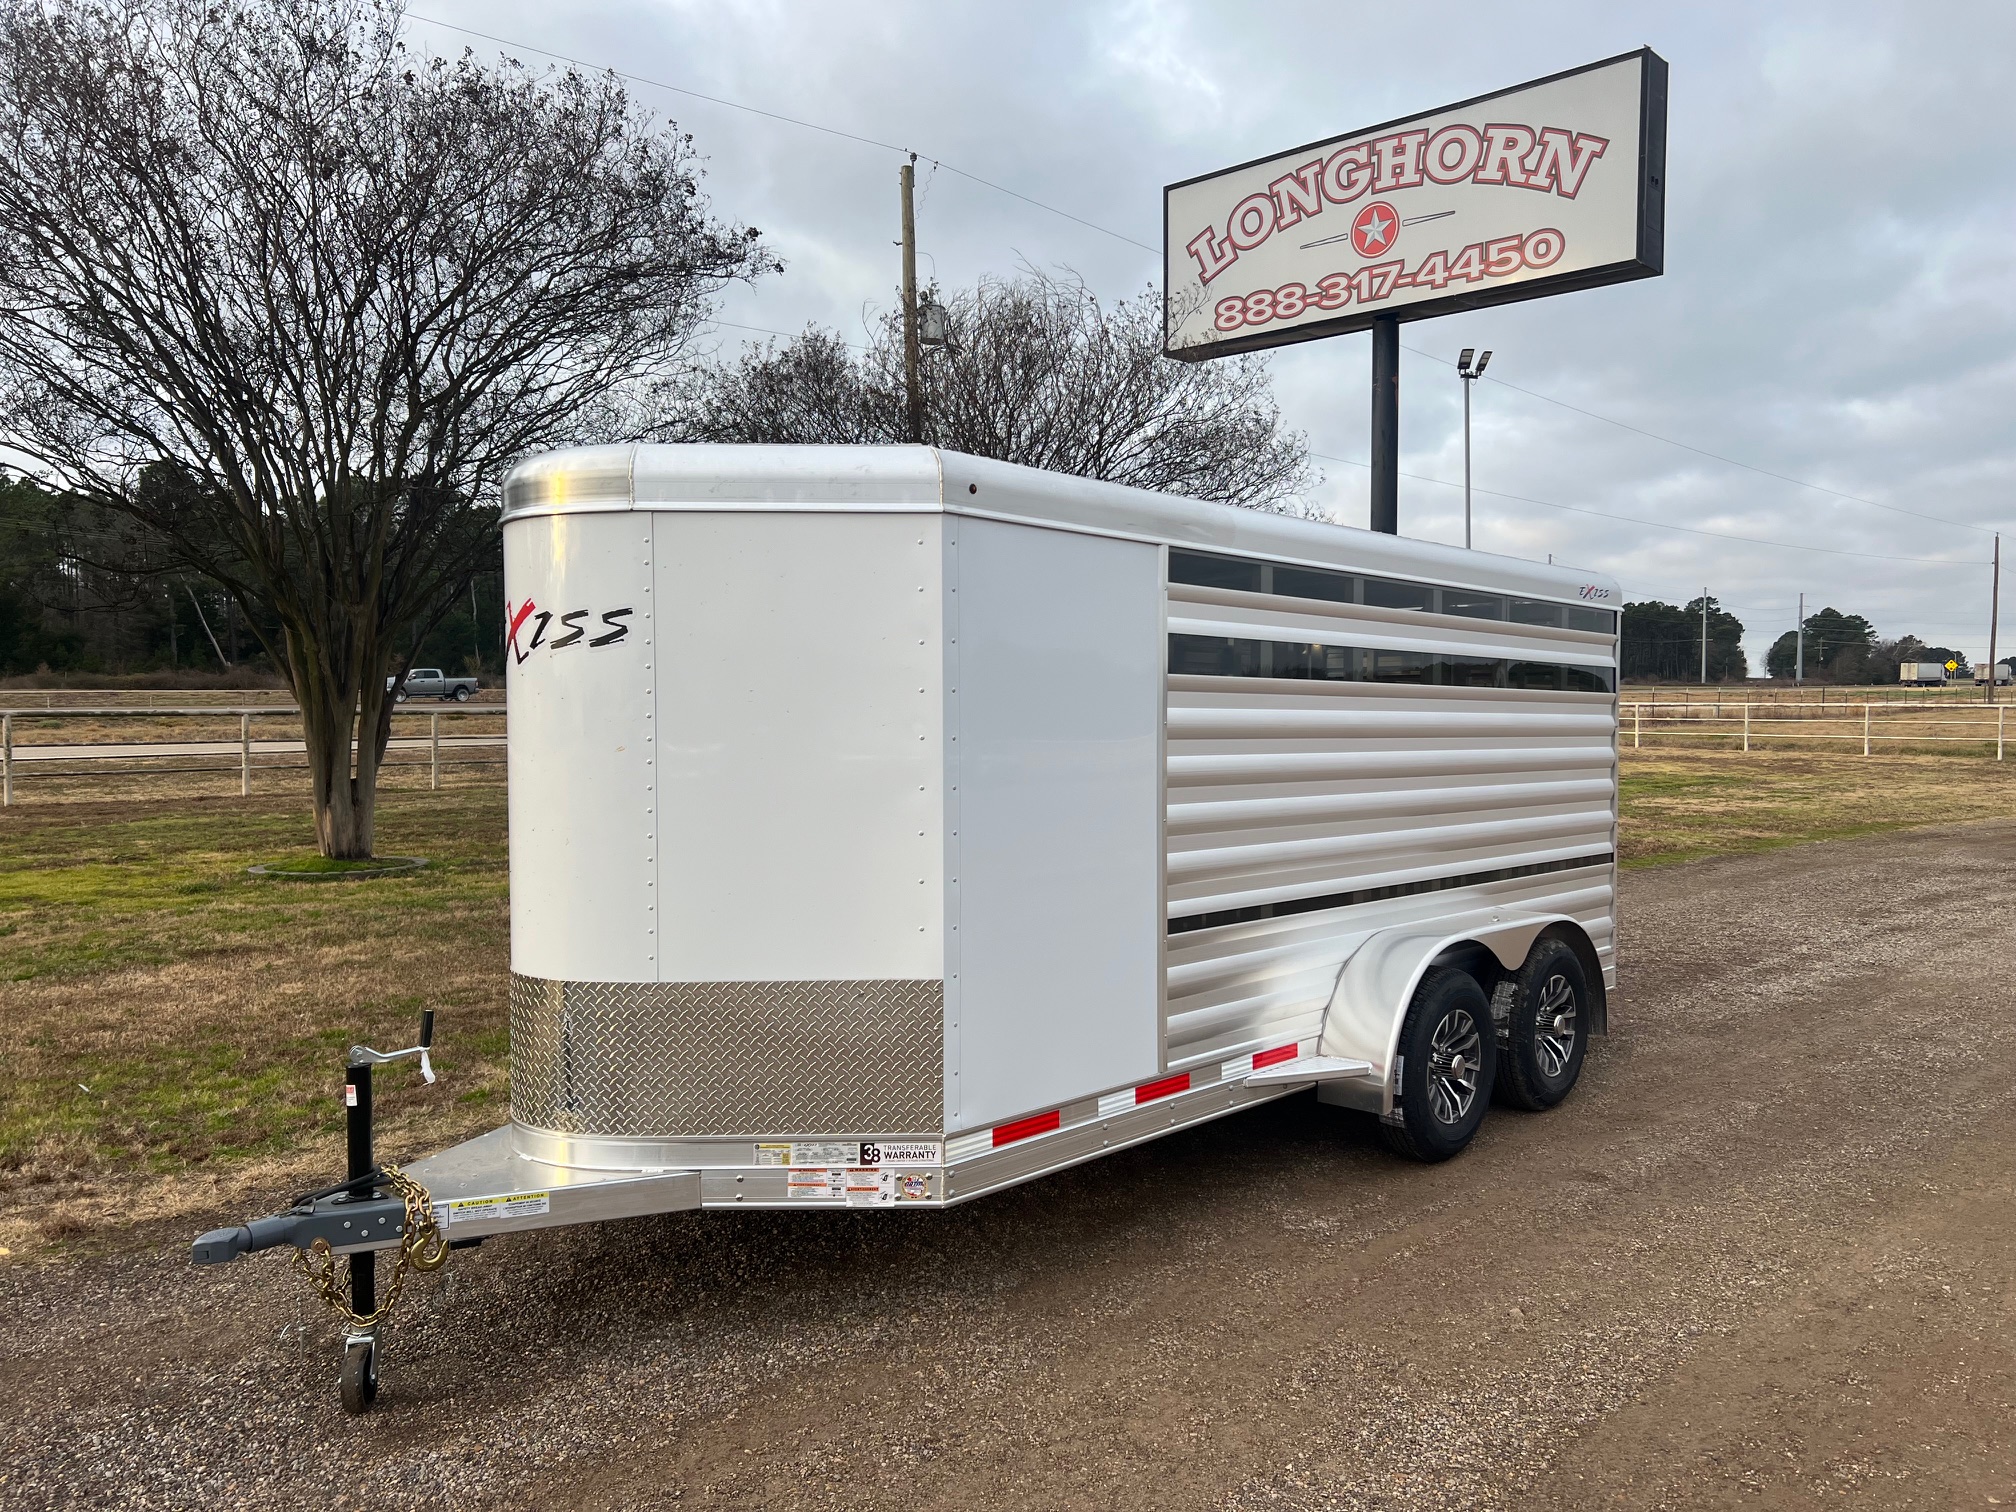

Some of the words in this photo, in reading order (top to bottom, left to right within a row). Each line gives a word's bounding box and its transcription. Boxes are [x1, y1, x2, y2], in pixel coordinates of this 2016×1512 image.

[1186, 123, 1609, 285] LONGHORN
[1213, 228, 1566, 332] 888-317-4450
[883, 1151, 937, 1160] WARRANTY
[512, 1193, 544, 1201] ATTENTION
